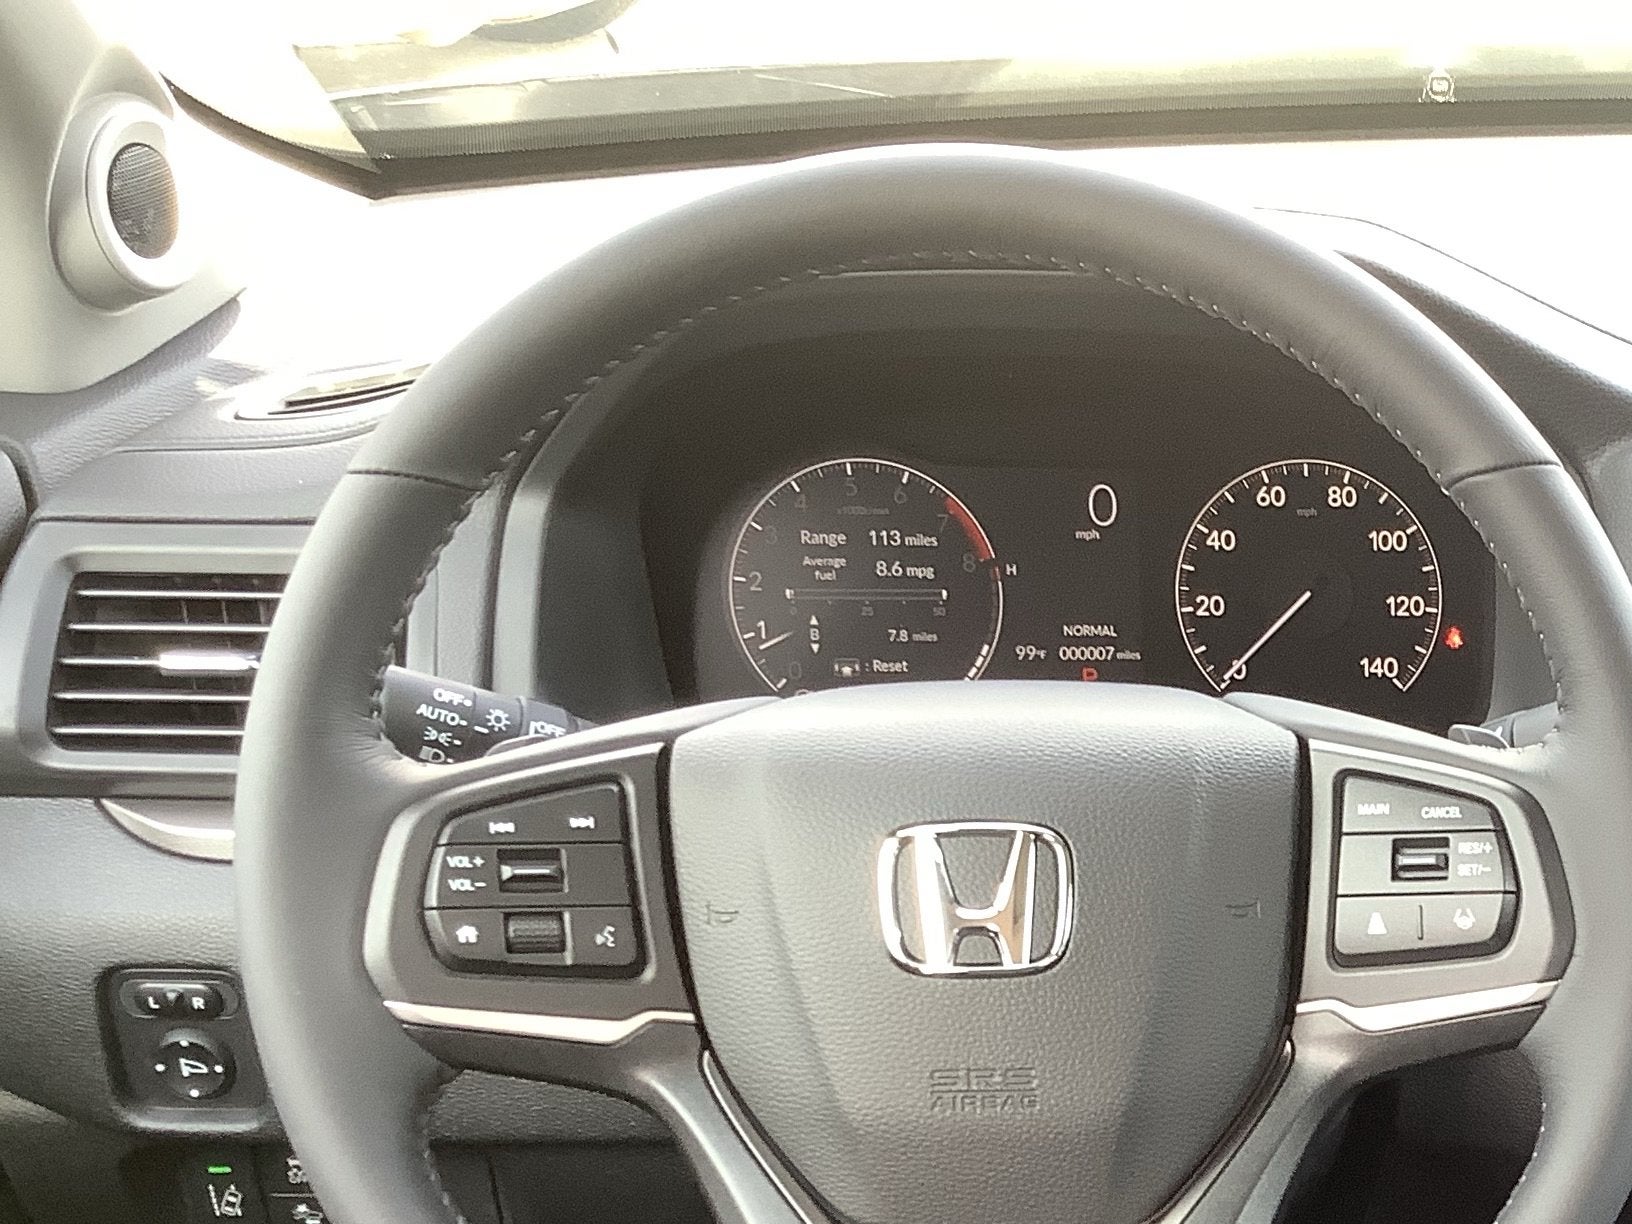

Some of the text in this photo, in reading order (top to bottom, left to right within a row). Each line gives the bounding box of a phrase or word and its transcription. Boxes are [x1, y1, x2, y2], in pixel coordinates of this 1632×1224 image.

[1256, 486, 1286, 507] 60
[1327, 486, 1357, 507] 80
[1088, 484, 1118, 527] 0
[800, 530, 938, 546] Range 113 miles
[1075, 530, 1100, 542] mph
[1206, 530, 1236, 551] 40
[1368, 531, 1407, 551] 100
[802, 556, 847, 568] Average
[875, 561, 934, 579] 8.6 mpg
[962, 554, 976, 572] 8
[1005, 564, 1017, 576] H
[749, 572, 763, 591] 2
[814, 569, 837, 581] fuel
[1195, 596, 1225, 616] 20
[1386, 596, 1425, 616] 120
[756, 620, 766, 638] 1
[810, 628, 820, 641] B
[887, 629, 938, 642] 7.8 miles
[1063, 624, 1118, 637] NORMAL
[1059, 646, 1115, 661] 000007
[1117, 649, 1141, 661] miles
[872, 659, 909, 673] Reset
[1360, 657, 1399, 677] 140
[433, 687, 465, 706] OFF
[416, 703, 460, 726] AUTO
[1357, 803, 1390, 816] MAIN
[1421, 806, 1462, 819] CANCEL
[148, 996, 160, 1009] L
[191, 996, 205, 1010] R
